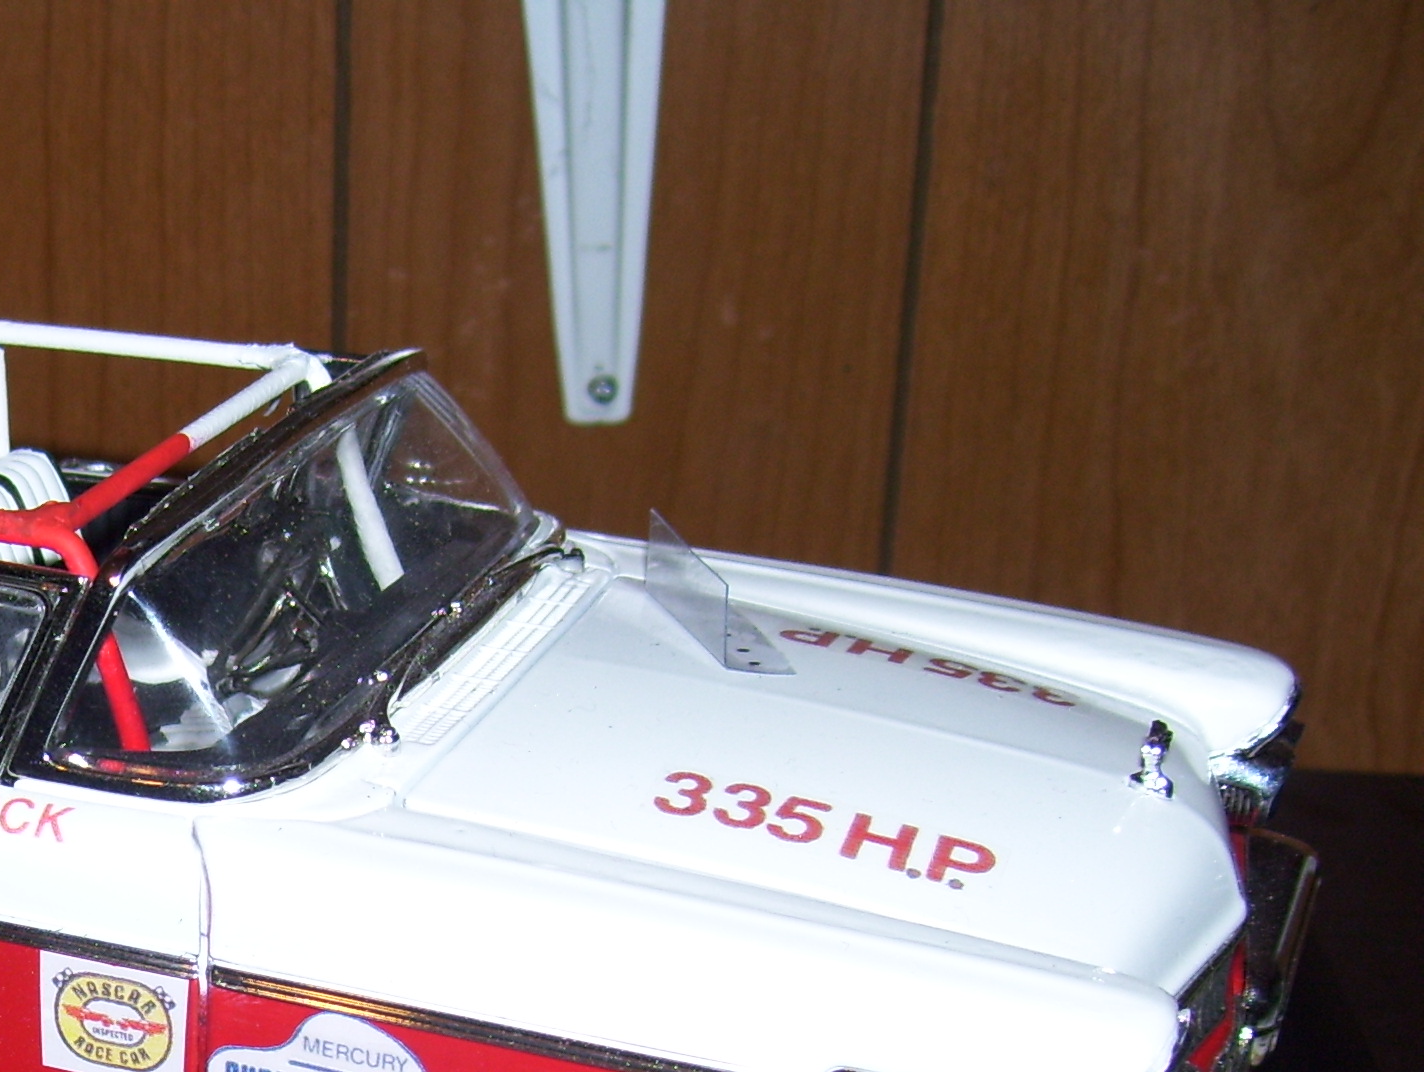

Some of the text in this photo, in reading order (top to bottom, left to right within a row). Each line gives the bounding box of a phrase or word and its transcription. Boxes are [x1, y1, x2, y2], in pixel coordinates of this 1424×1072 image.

[654, 770, 997, 890] 335 H.P.
[72, 980, 157, 1015] NASCAR
[74, 1035, 152, 1066] RACE CAR
[92, 1026, 134, 1042] INSPECTED
